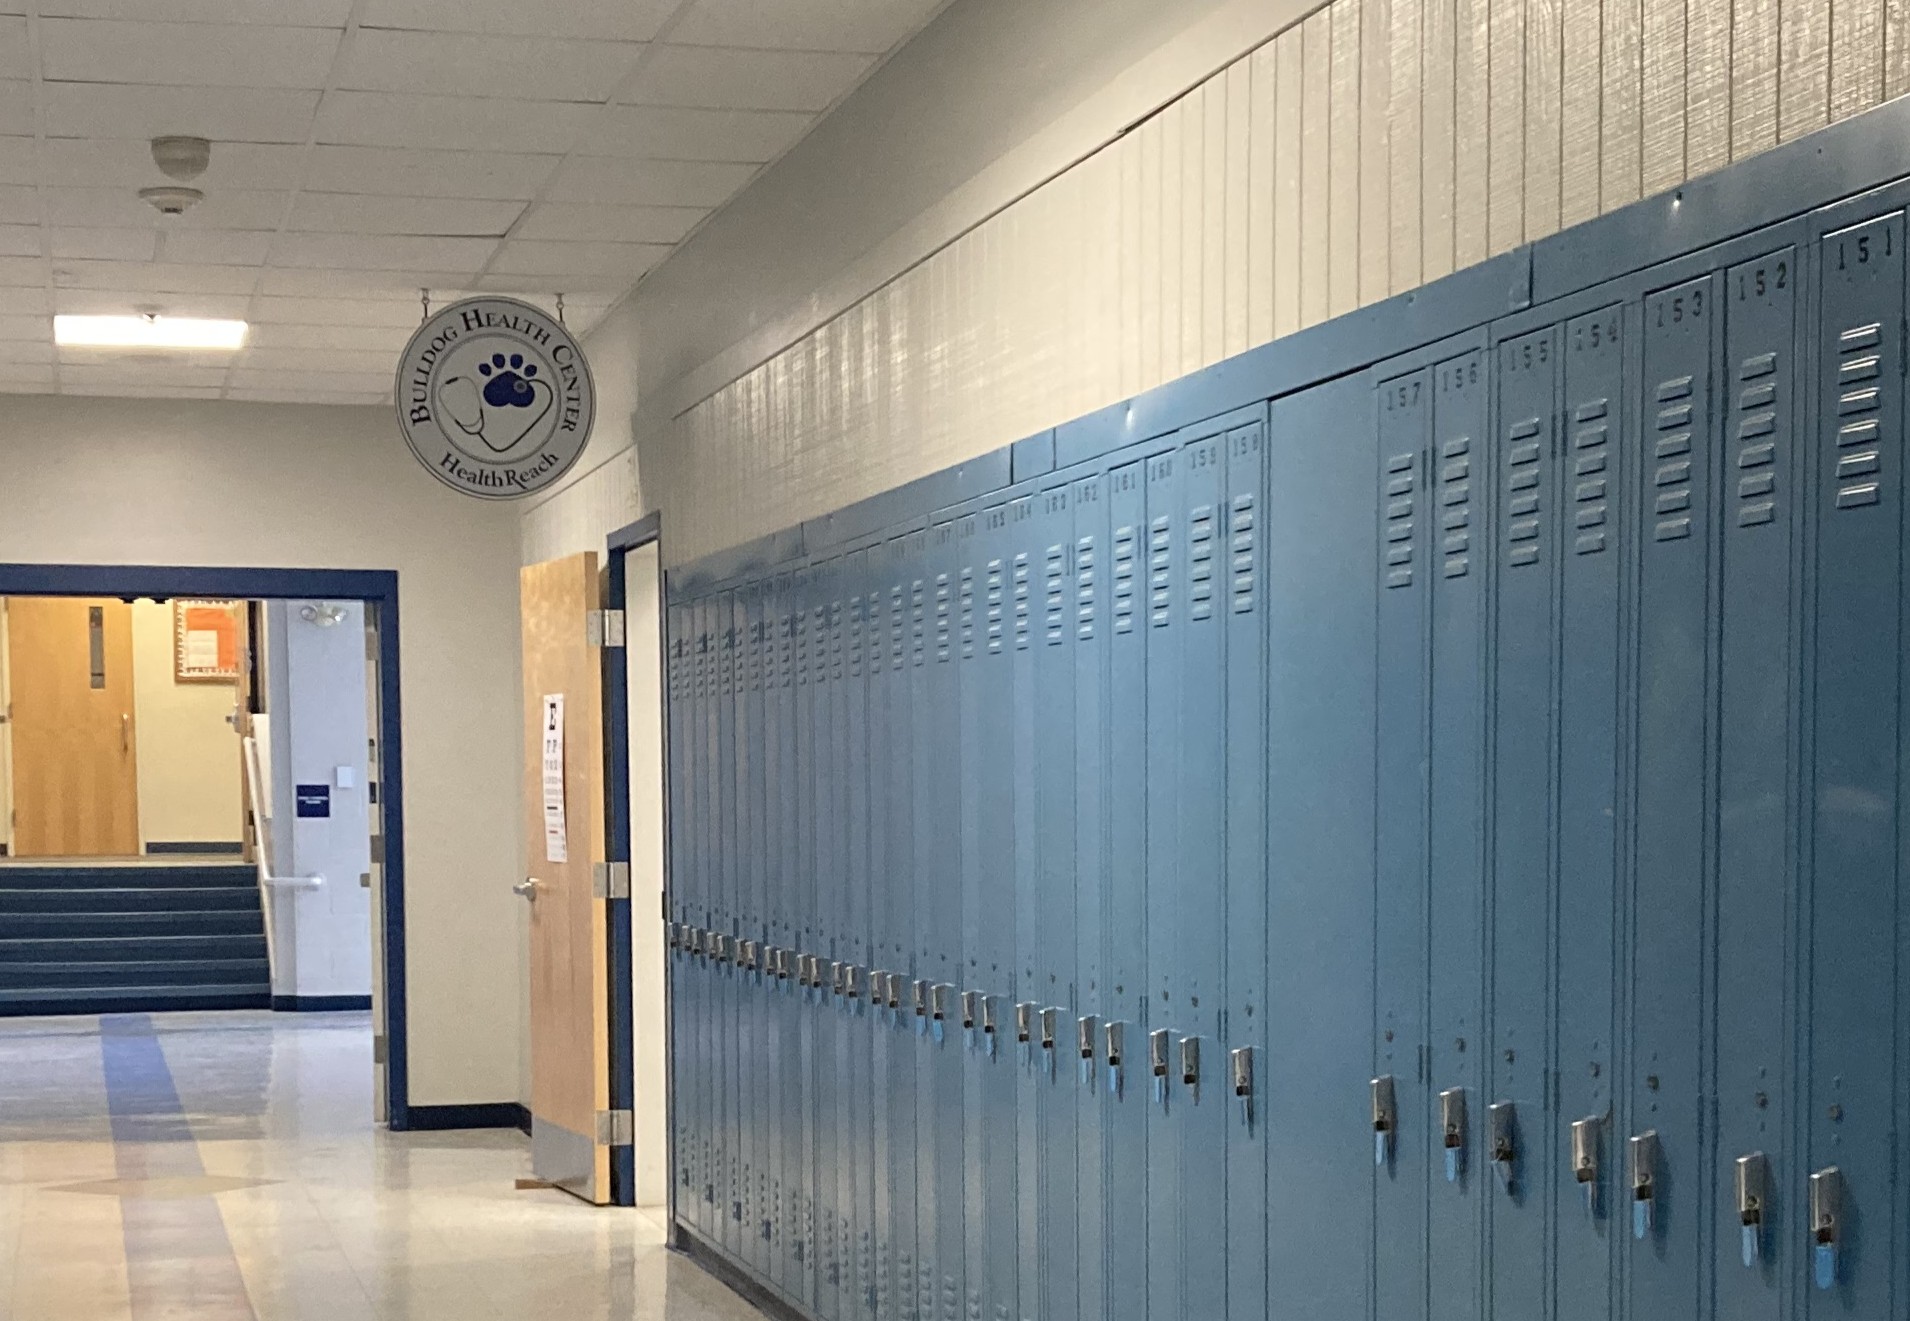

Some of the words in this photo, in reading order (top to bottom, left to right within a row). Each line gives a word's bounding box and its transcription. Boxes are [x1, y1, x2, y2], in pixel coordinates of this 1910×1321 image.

[1836, 225, 1893, 271] 151
[1737, 261, 1788, 301] 152
[1655, 289, 1703, 328] 153
[1573, 316, 1618, 351] 154
[461, 308, 551, 346] HEALTH
[552, 344, 581, 433] CENTER
[1508, 338, 1549, 371] 155
[1441, 359, 1479, 393] 156
[1386, 381, 1422, 411] 157
